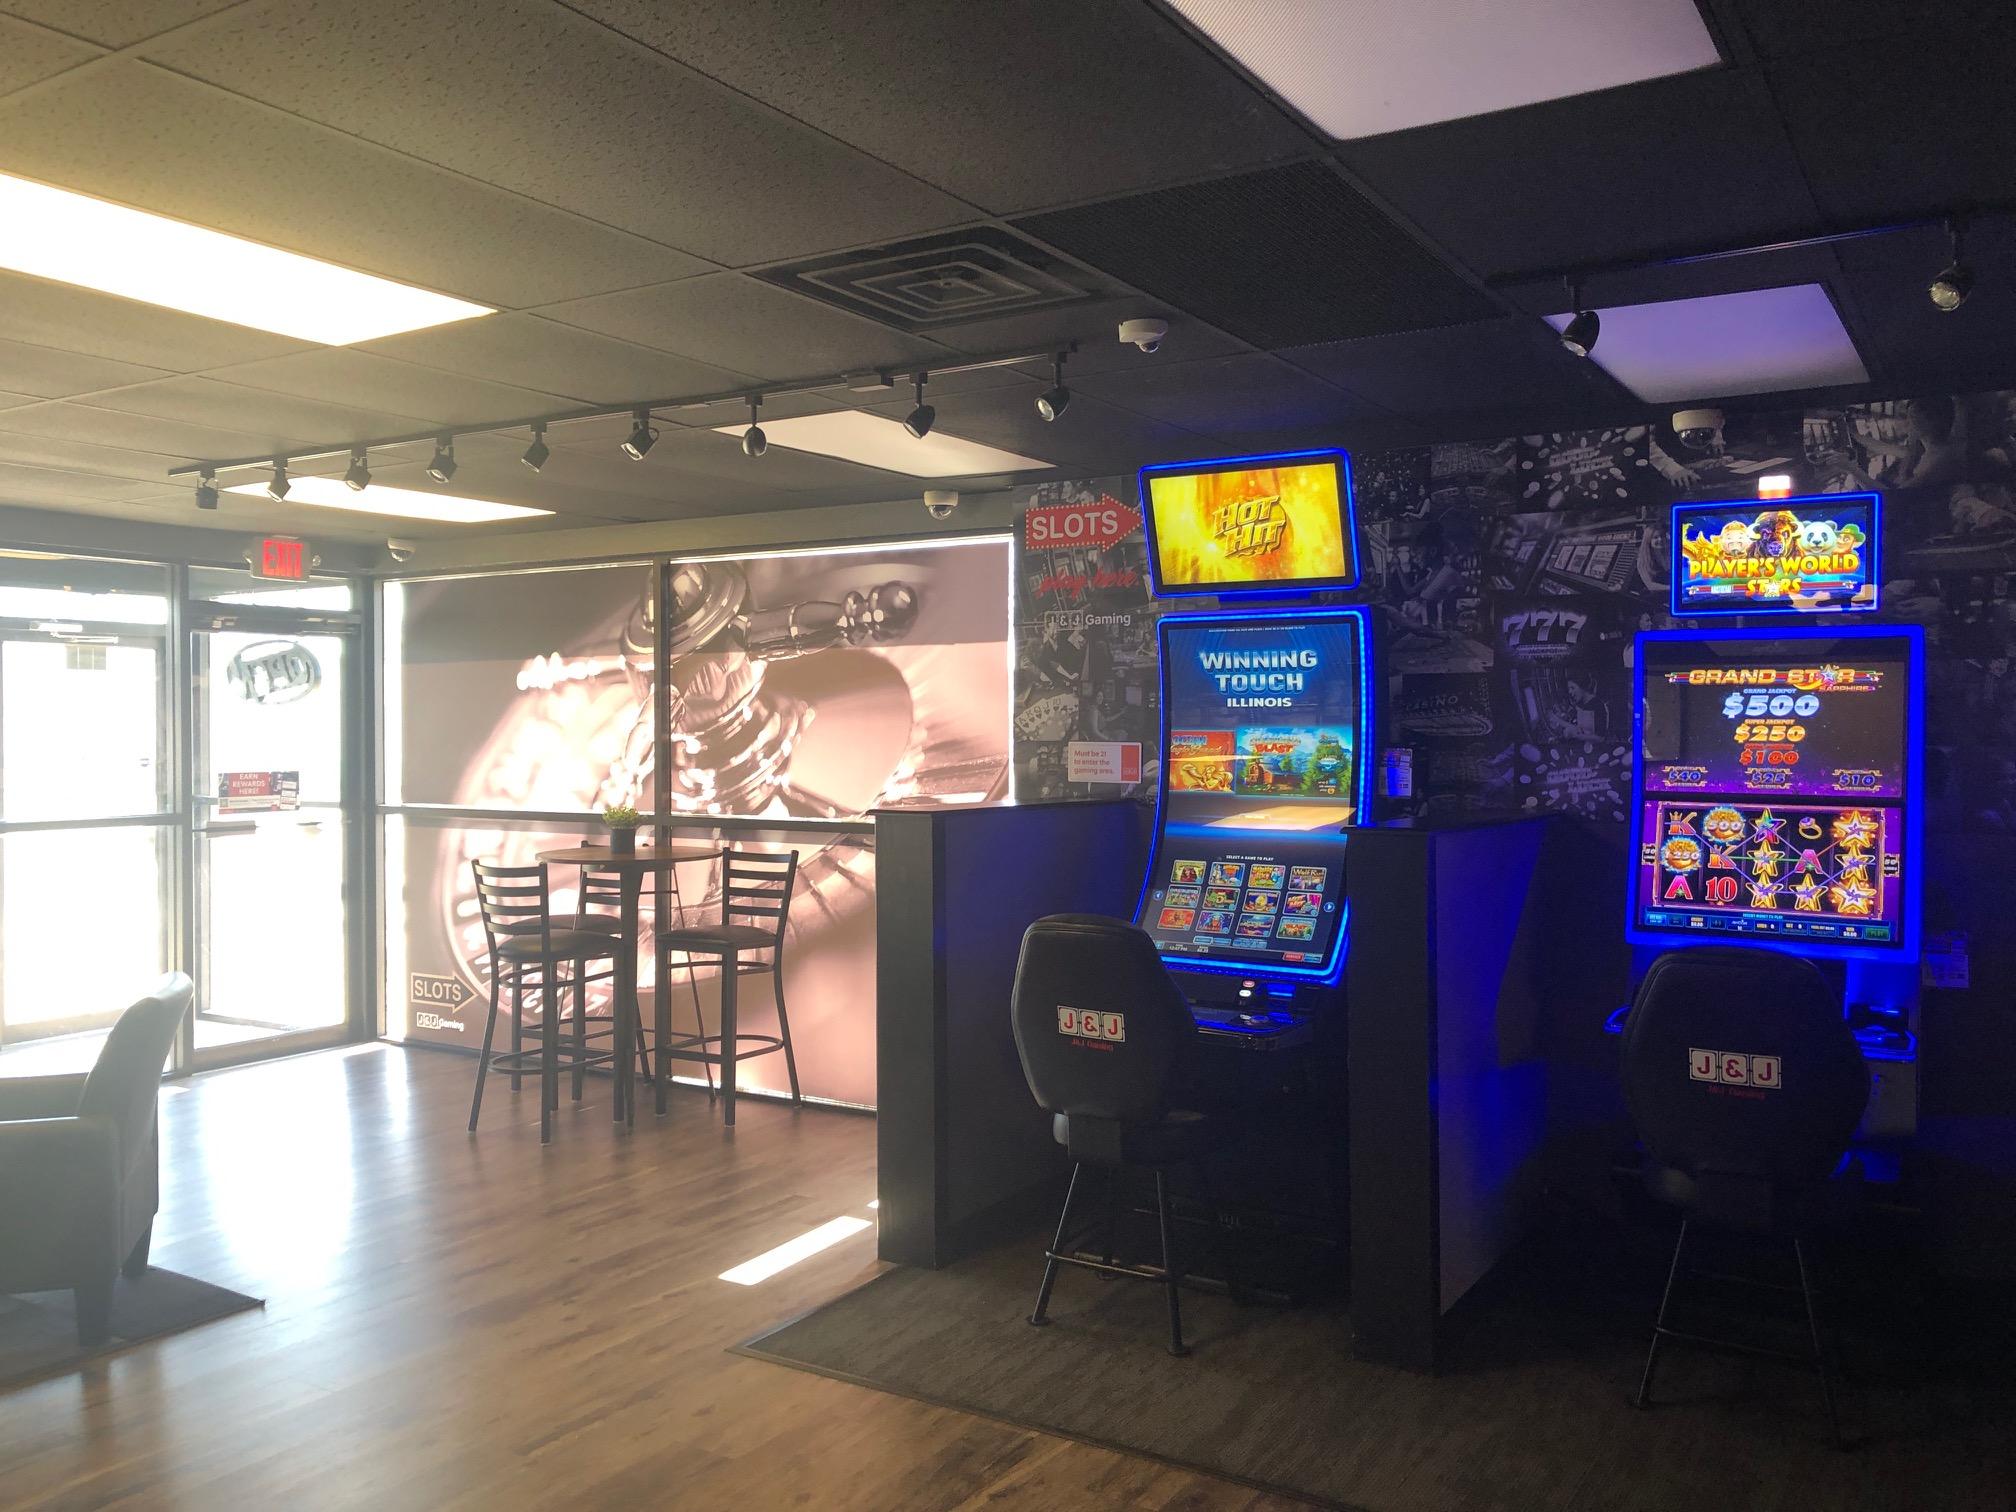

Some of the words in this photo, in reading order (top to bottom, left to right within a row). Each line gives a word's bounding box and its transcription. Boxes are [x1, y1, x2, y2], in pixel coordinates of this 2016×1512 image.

[1212, 494, 1280, 536] HOT
[1032, 510, 1118, 541] SLOTS
[1225, 518, 1287, 559] HIT
[263, 540, 302, 578] EXIT
[1689, 557, 1775, 578] PLAYER'S
[1781, 553, 1858, 575] WORLD
[1085, 613, 1131, 627] Gaming
[1200, 649, 1318, 673] WINNING
[1215, 673, 1304, 694] TOUCH
[1689, 669, 1776, 685] GRAND
[1227, 697, 1292, 708] ILLINOIS
[1722, 692, 1820, 718] $500
[1734, 723, 1806, 743] $250
[1255, 743, 1294, 754] BLAST
[1739, 749, 1799, 765] $100
[232, 780, 265, 788] REWARDS
[1668, 770, 1702, 782] $40
[1752, 772, 1786, 784] $25
[1839, 774, 1876, 786] $10
[1705, 876, 1738, 902] 10
[414, 980, 462, 1002] SLOTS
[439, 1018, 465, 1032] Gaming
